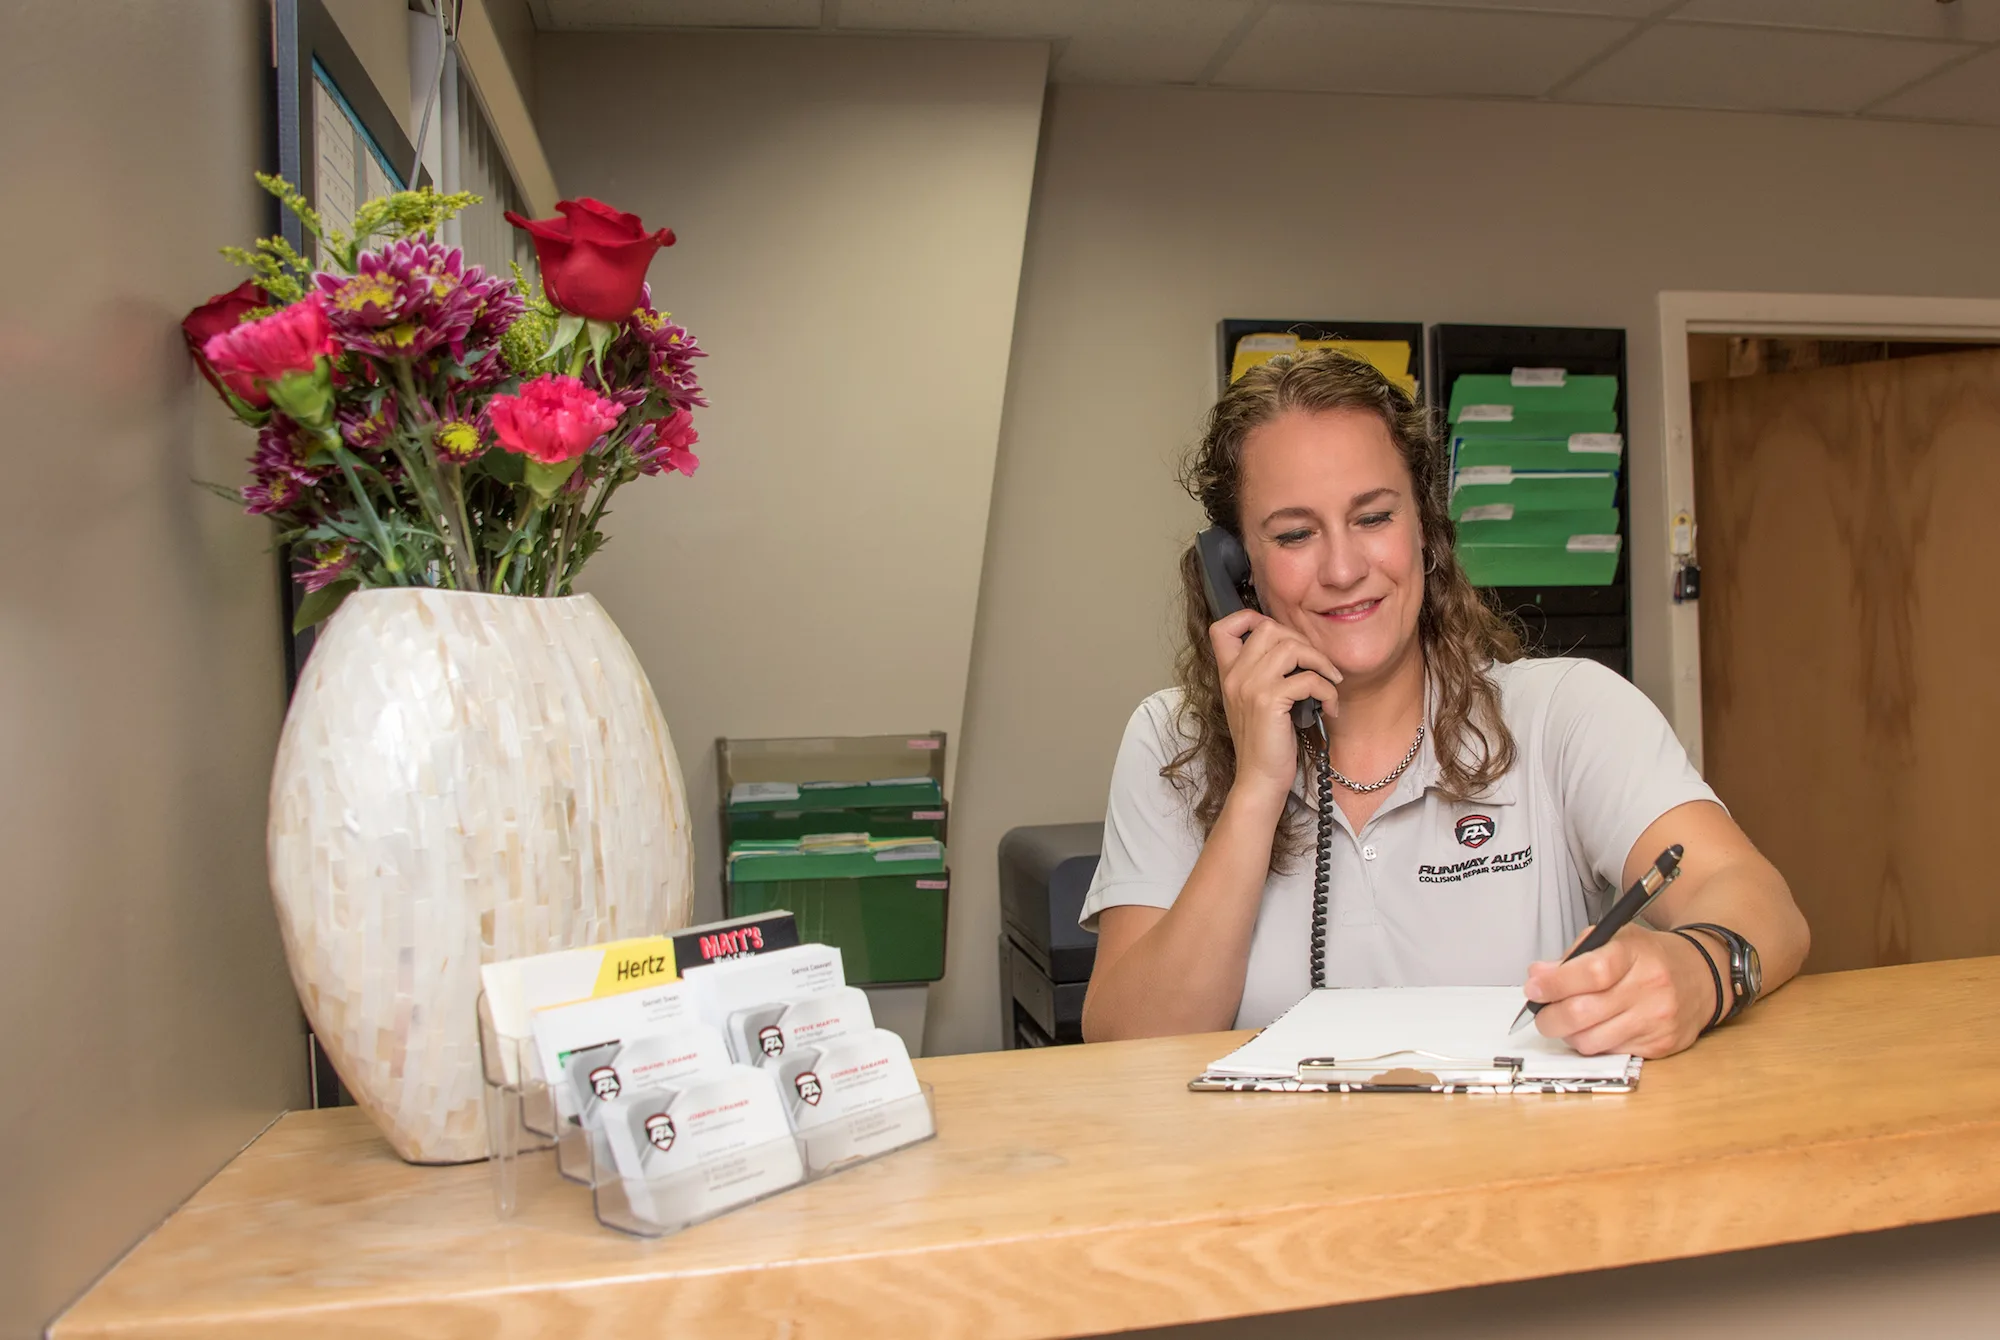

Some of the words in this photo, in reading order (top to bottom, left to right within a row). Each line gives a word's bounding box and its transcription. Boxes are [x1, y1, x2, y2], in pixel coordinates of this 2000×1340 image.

[1418, 856, 1489, 875] RUNWAY
[1491, 845, 1532, 864] AUTO
[1419, 874, 1461, 883] COLLISION
[1463, 866, 1489, 879] REPAIR
[699, 926, 764, 960] MATT'S
[617, 955, 665, 981] Hertz
[816, 1018, 840, 1029] MARTIN
